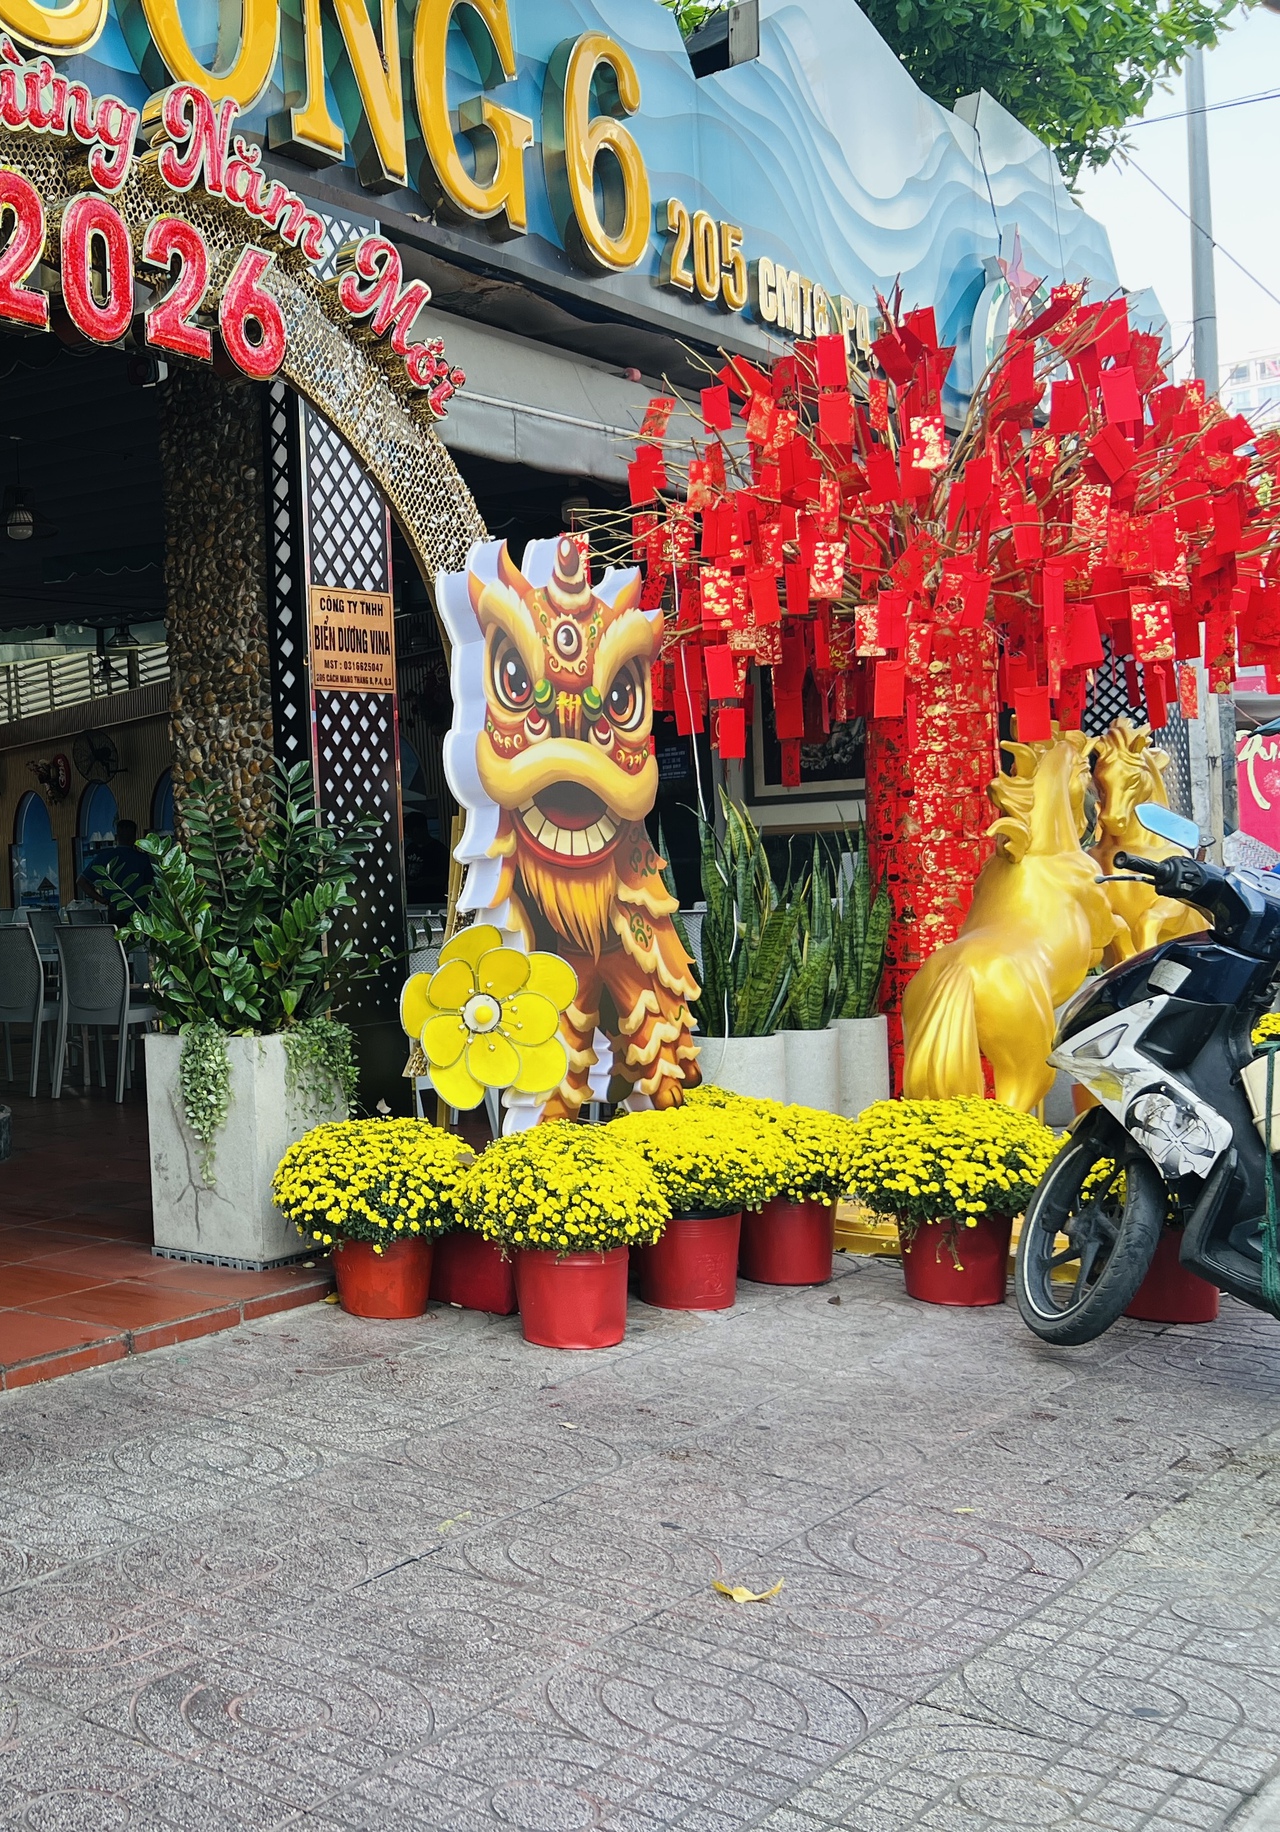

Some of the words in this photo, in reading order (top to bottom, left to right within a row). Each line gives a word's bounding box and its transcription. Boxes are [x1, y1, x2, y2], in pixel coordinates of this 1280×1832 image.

[562, 30, 652, 272] 6
[158, 81, 328, 262] Năm
[339, 234, 467, 421] Mới
[666, 197, 748, 312] 205
[314, 615, 336, 651] BIỂN
[338, 625, 368, 654] DƯƠNG
[370, 630, 391, 656] VINA
[319, 595, 345, 613] CÔNG
[347, 600, 358, 614] TY
[359, 602, 384, 617] TNHH
[324, 659, 338, 669] MST
